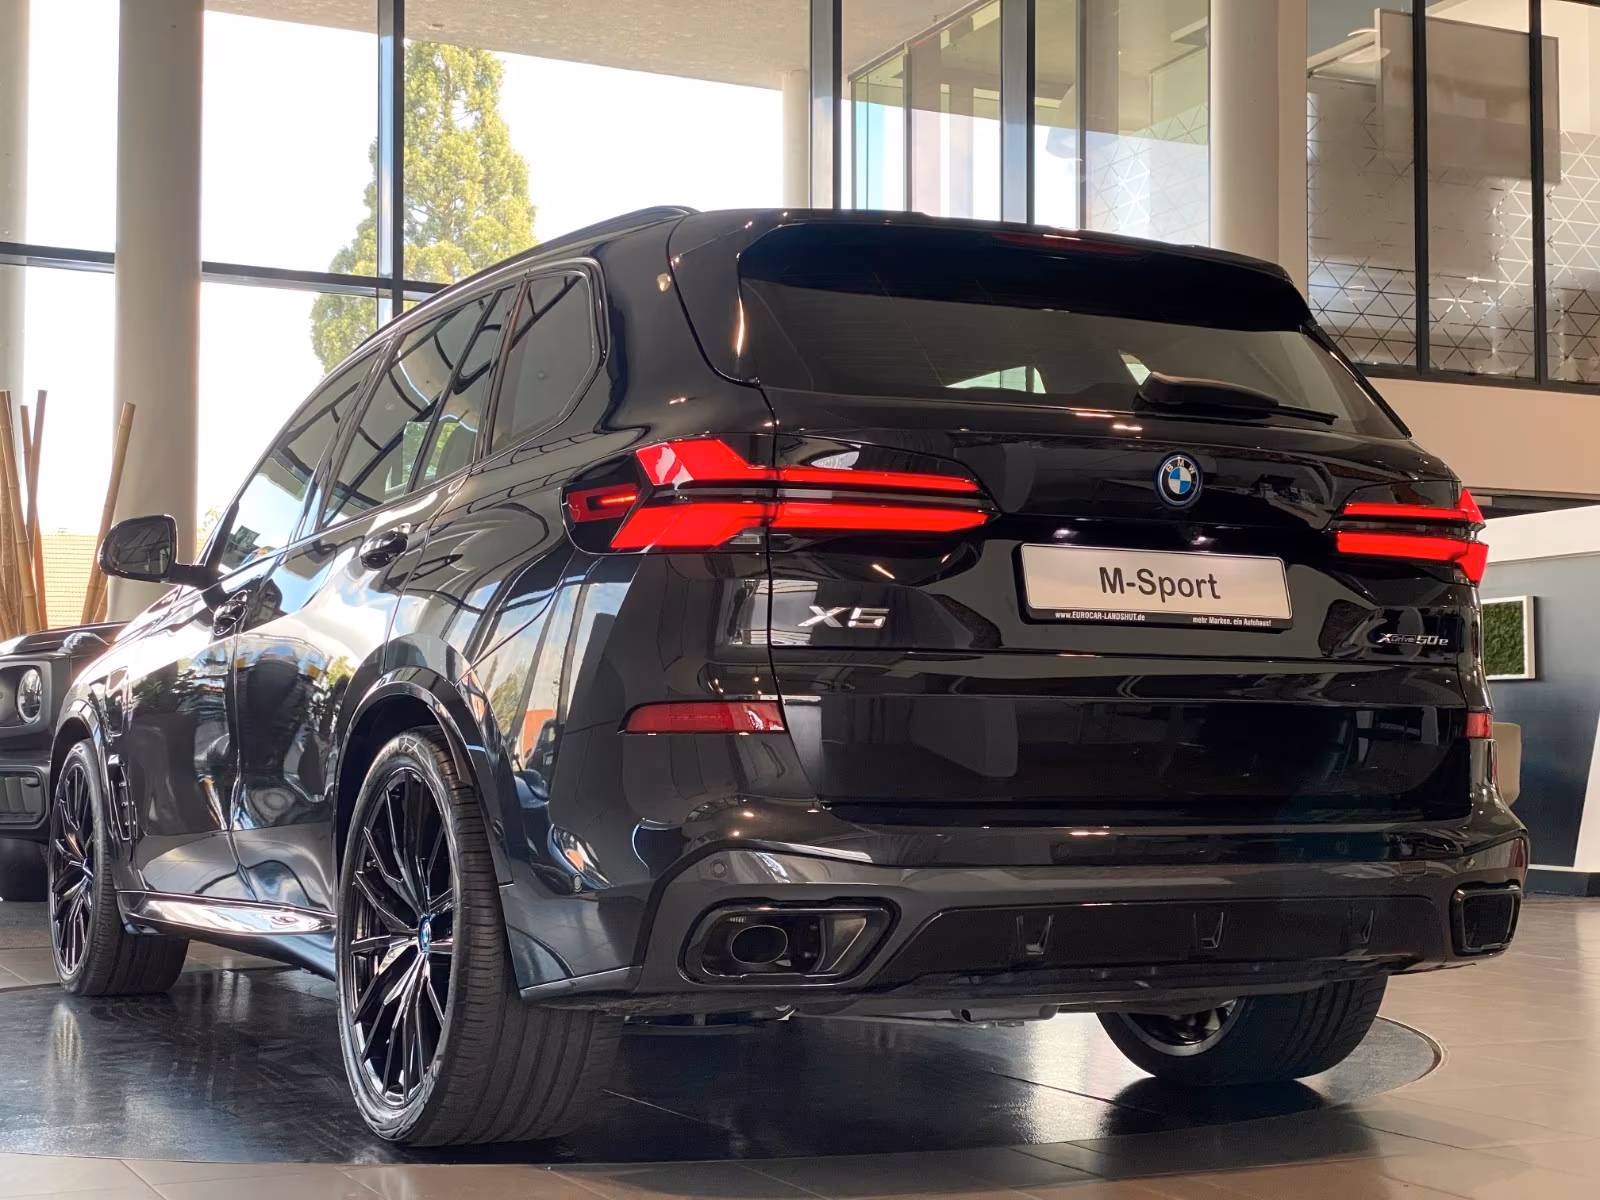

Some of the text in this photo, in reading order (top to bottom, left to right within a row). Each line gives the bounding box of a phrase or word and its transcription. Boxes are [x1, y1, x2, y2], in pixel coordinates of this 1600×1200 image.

[1165, 457, 1196, 474] BMW
[1099, 566, 1221, 603] M-Sport
[797, 605, 890, 629] X5
[1054, 611, 1146, 621] www.EUROCAR-LANDSHUT.de
[1233, 618, 1243, 626] ein
